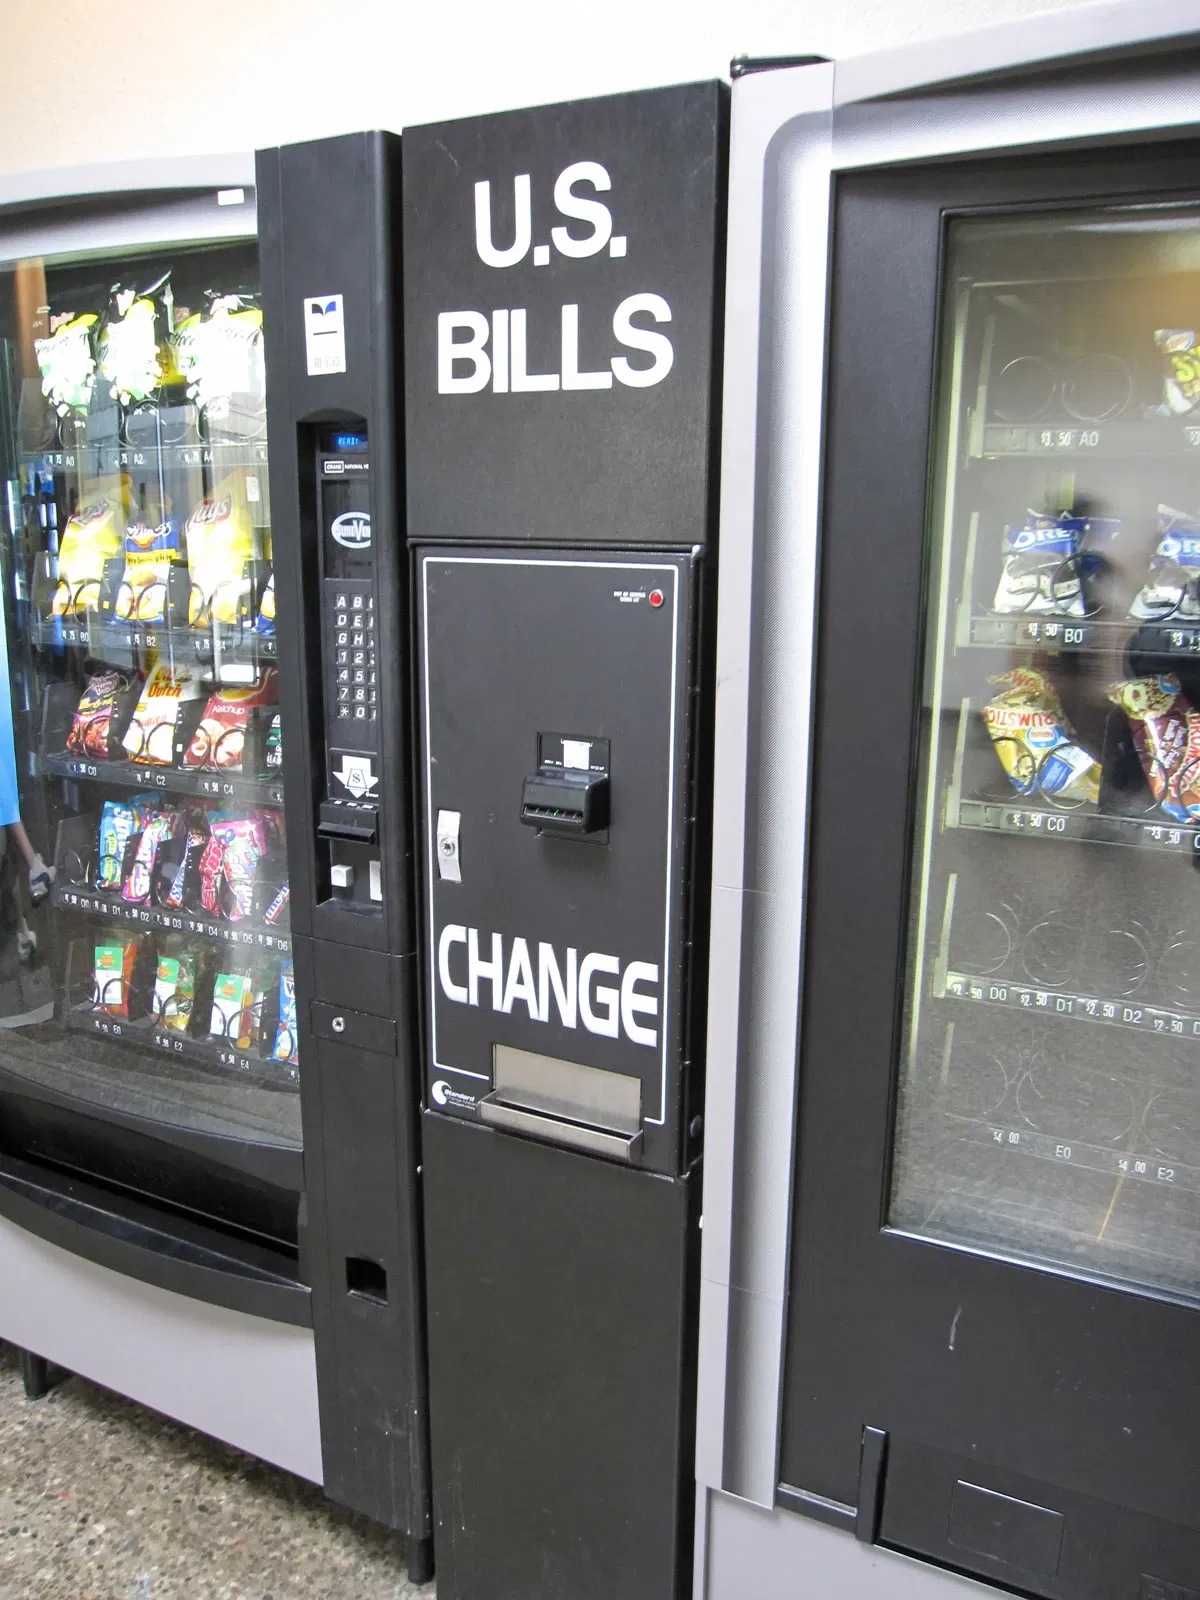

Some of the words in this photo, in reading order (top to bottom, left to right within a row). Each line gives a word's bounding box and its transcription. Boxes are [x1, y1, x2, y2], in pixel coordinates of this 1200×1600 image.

[475, 161, 627, 268] U.S.
[437, 292, 674, 394] BILLS
[1079, 431, 1099, 446] A0
[134, 453, 144, 465] A2
[337, 595, 346, 607] A
[353, 597, 362, 608] B
[338, 614, 347, 626] D
[353, 615, 362, 627] E
[338, 633, 347, 644] G
[354, 634, 363, 645] H
[1064, 629, 1083, 643] B0
[340, 651, 347, 662] 1
[355, 652, 363, 664] 2
[340, 669, 348, 681] 4
[355, 671, 363, 682] 5
[341, 688, 348, 698] 7
[356, 689, 364, 700] 8
[212, 704, 245, 716] Ketchup
[156, 775, 166, 786] C2
[224, 784, 234, 795] C4
[1047, 817, 1065, 832] C0
[112, 905, 121, 915] D1
[140, 912, 150, 922] D2
[173, 918, 182, 928] D3
[208, 926, 218, 936] D4
[243, 934, 253, 944] D5
[277, 940, 288, 951] D6
[439, 924, 659, 1047] CHANGE
[990, 987, 1007, 1001] D0
[1021, 994, 1047, 1006] $2.50
[1056, 999, 1072, 1012] D1
[1086, 1000, 1115, 1017] $2.50
[1123, 1008, 1142, 1023] D2
[1154, 1019, 1183, 1033] $2.50
[174, 1041, 183, 1051] E2
[240, 1059, 249, 1069] E4
[445, 1089, 475, 1101] Standard
[1055, 1145, 1072, 1160] E0
[1157, 1167, 1174, 1182] E2
